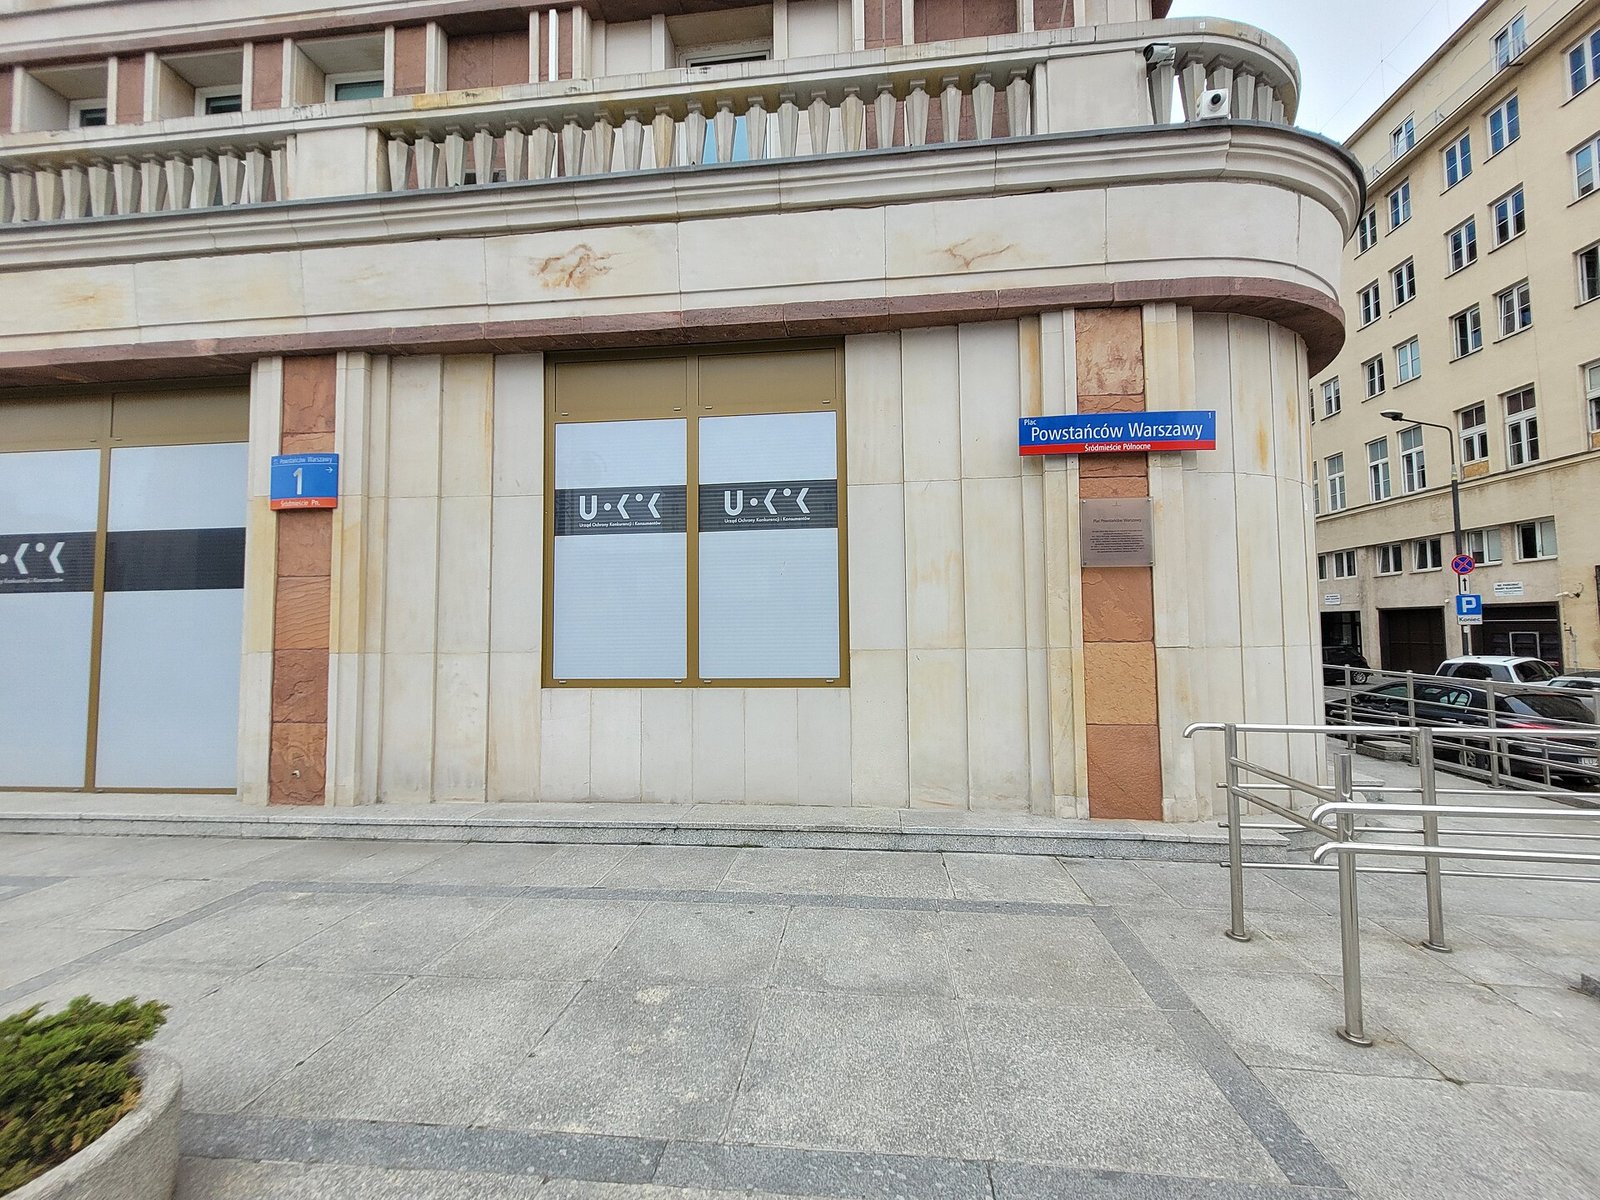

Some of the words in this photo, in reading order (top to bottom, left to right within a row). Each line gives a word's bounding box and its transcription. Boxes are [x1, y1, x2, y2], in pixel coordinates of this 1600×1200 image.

[1031, 423, 1124, 441] Powstańców
[1127, 422, 1203, 440] Warszawy
[1084, 443, 1122, 452] Śródmieście
[1122, 442, 1151, 450] Północne
[293, 467, 303, 495] 1
[1461, 597, 1477, 613] P
